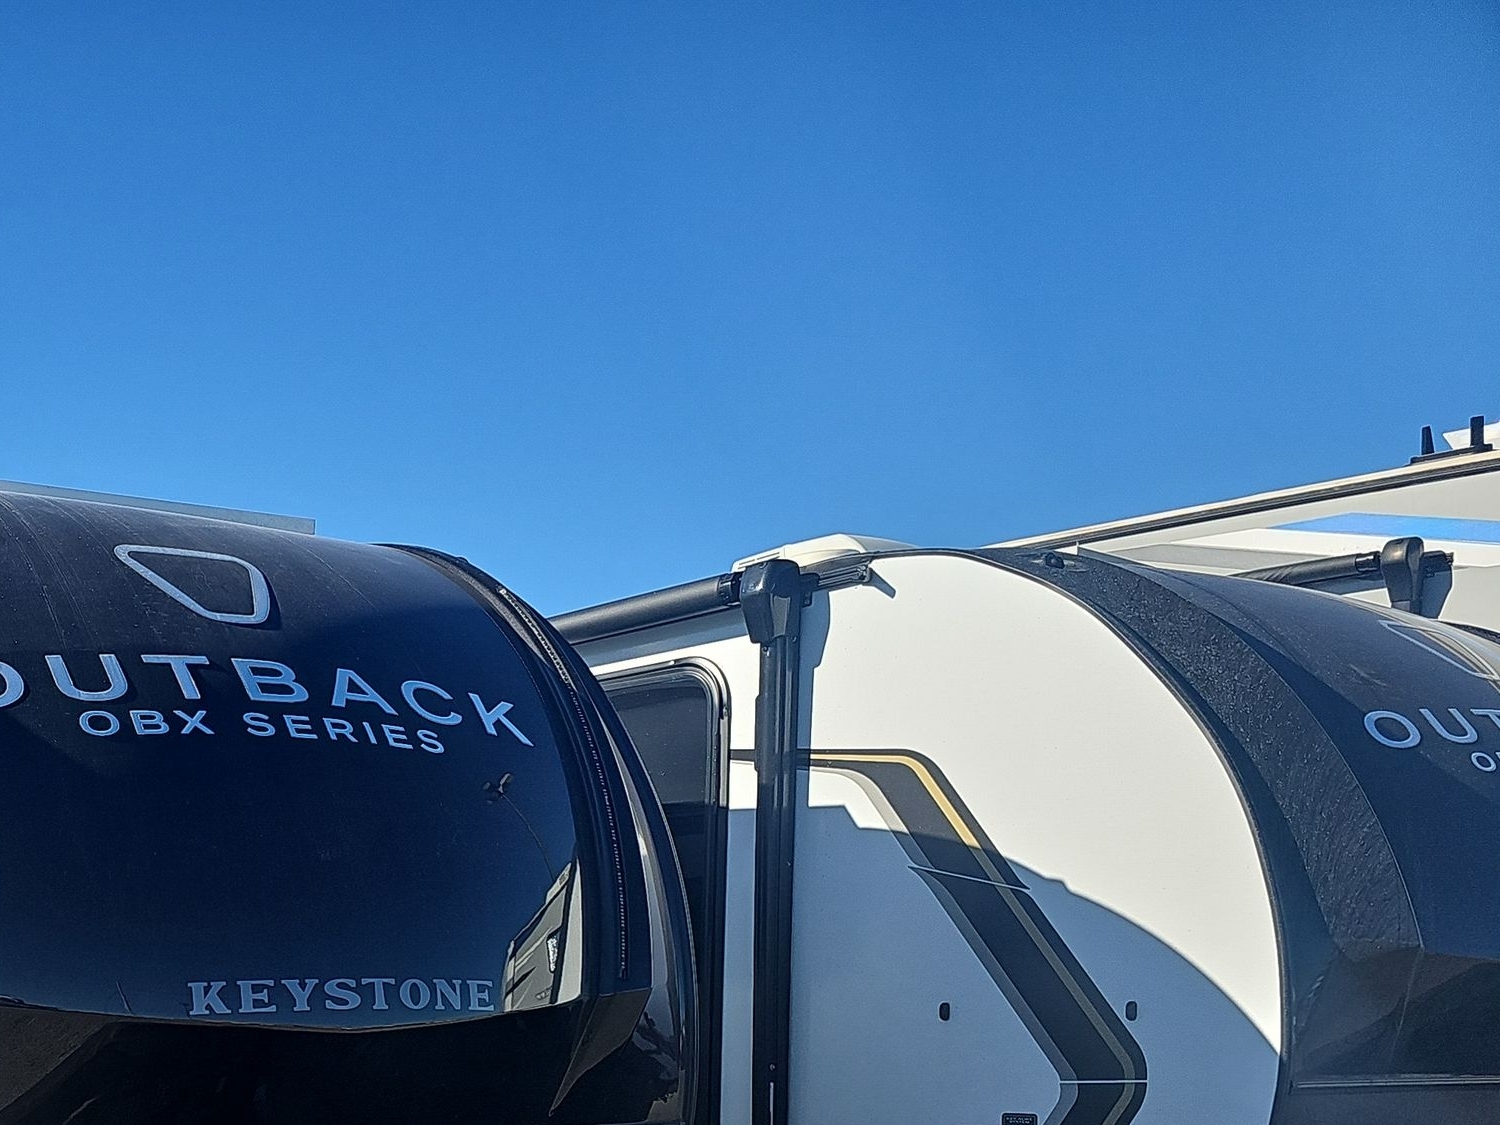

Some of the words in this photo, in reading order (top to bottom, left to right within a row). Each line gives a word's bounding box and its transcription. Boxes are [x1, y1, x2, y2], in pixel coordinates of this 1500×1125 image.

[79, 709, 214, 737] OBX
[243, 711, 445, 754] SERIES
[187, 977, 494, 1016] KEYSTONE
